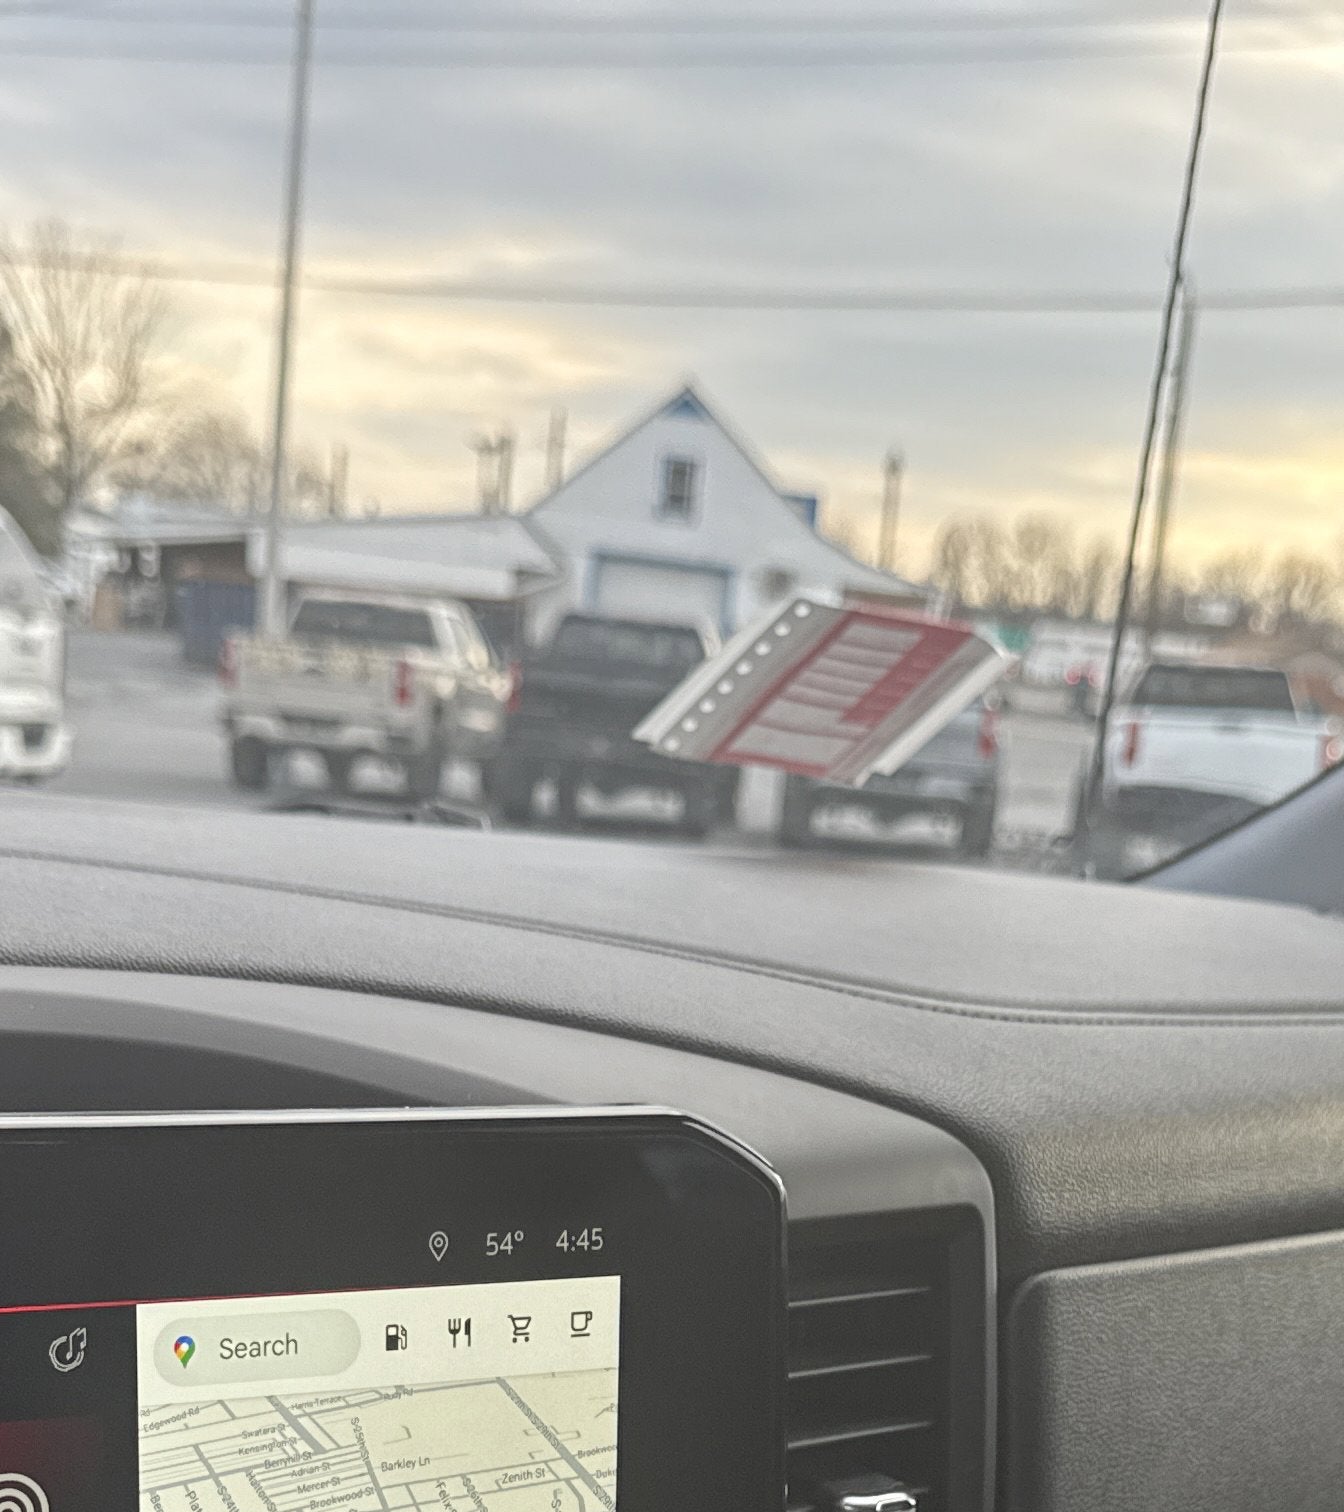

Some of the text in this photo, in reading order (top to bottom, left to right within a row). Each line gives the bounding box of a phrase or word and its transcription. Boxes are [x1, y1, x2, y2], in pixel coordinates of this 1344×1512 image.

[485, 1230, 525, 1256] 54°
[556, 1227, 604, 1253] 4:45
[218, 1332, 299, 1361] Search
[143, 1406, 200, 1433] Edgewood Rd
[277, 1422, 286, 1432] St
[288, 1436, 298, 1446] St
[302, 1450, 313, 1461] St
[381, 1455, 431, 1473] Barkley Ln
[290, 1461, 331, 1479] Adrian St
[501, 1468, 546, 1485] Zenith St
[216, 1485, 228, 1496] S
[297, 1476, 342, 1495] Mercer St
[309, 1486, 375, 1510] Brookwood St
[434, 1482, 455, 1510] Felix
[551, 1499, 561, 1508] S
